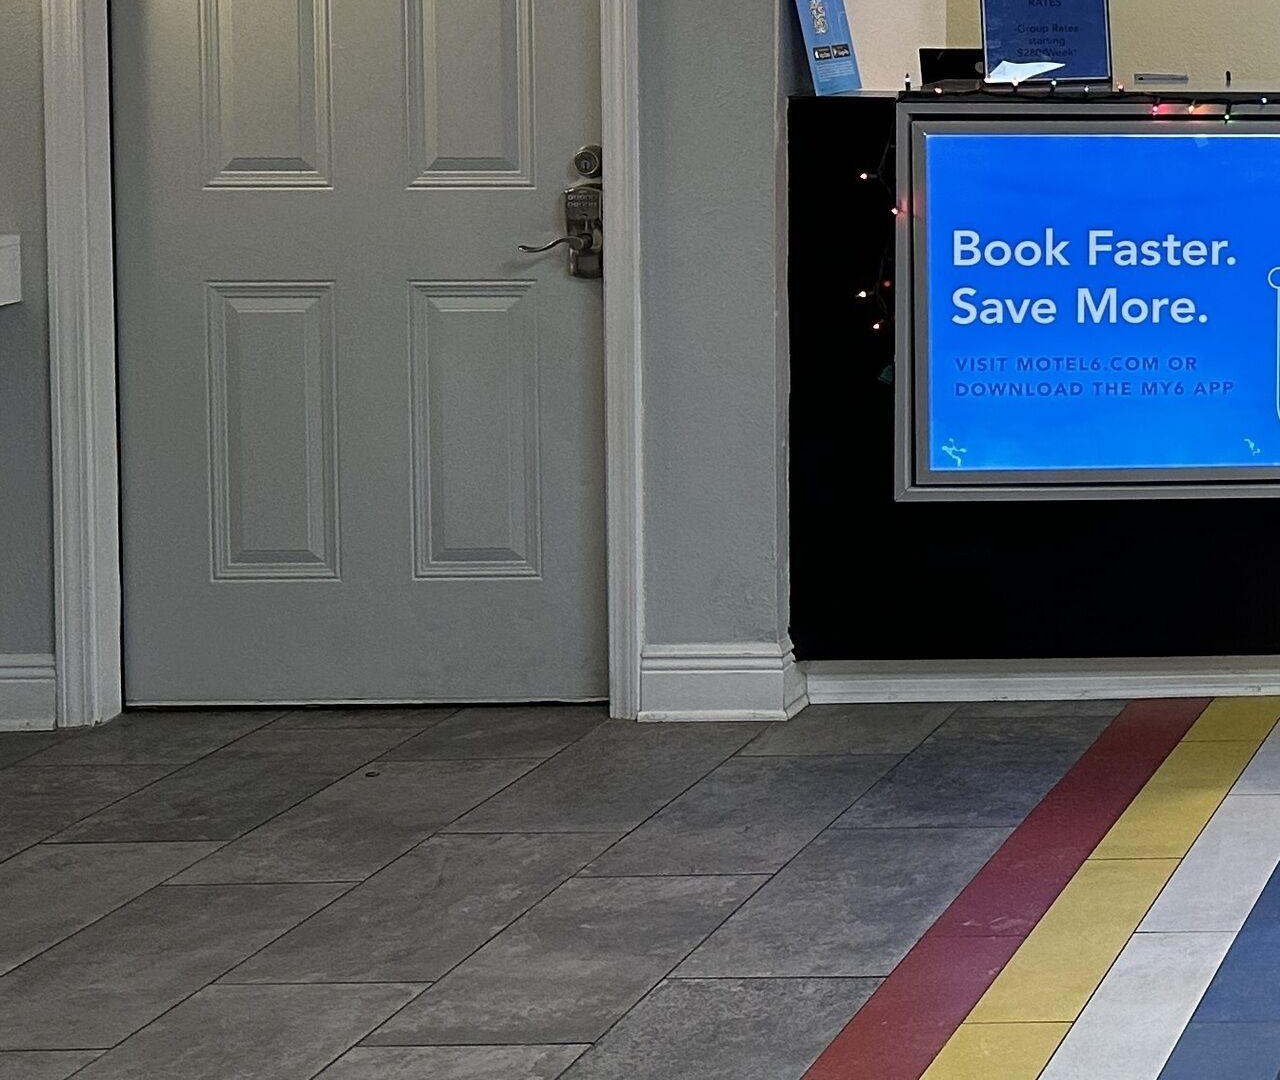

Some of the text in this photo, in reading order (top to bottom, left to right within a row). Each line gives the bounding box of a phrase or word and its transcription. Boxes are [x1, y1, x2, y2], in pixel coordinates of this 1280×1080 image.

[1016, 23, 1080, 34] Group Rates
[953, 227, 1237, 267] Book Faster.
[951, 286, 1208, 325] Save More.
[954, 356, 1198, 372] VISIT MOTEL6.COM OR
[954, 380, 1236, 398] DOWNLOAD THE MY6 APP
